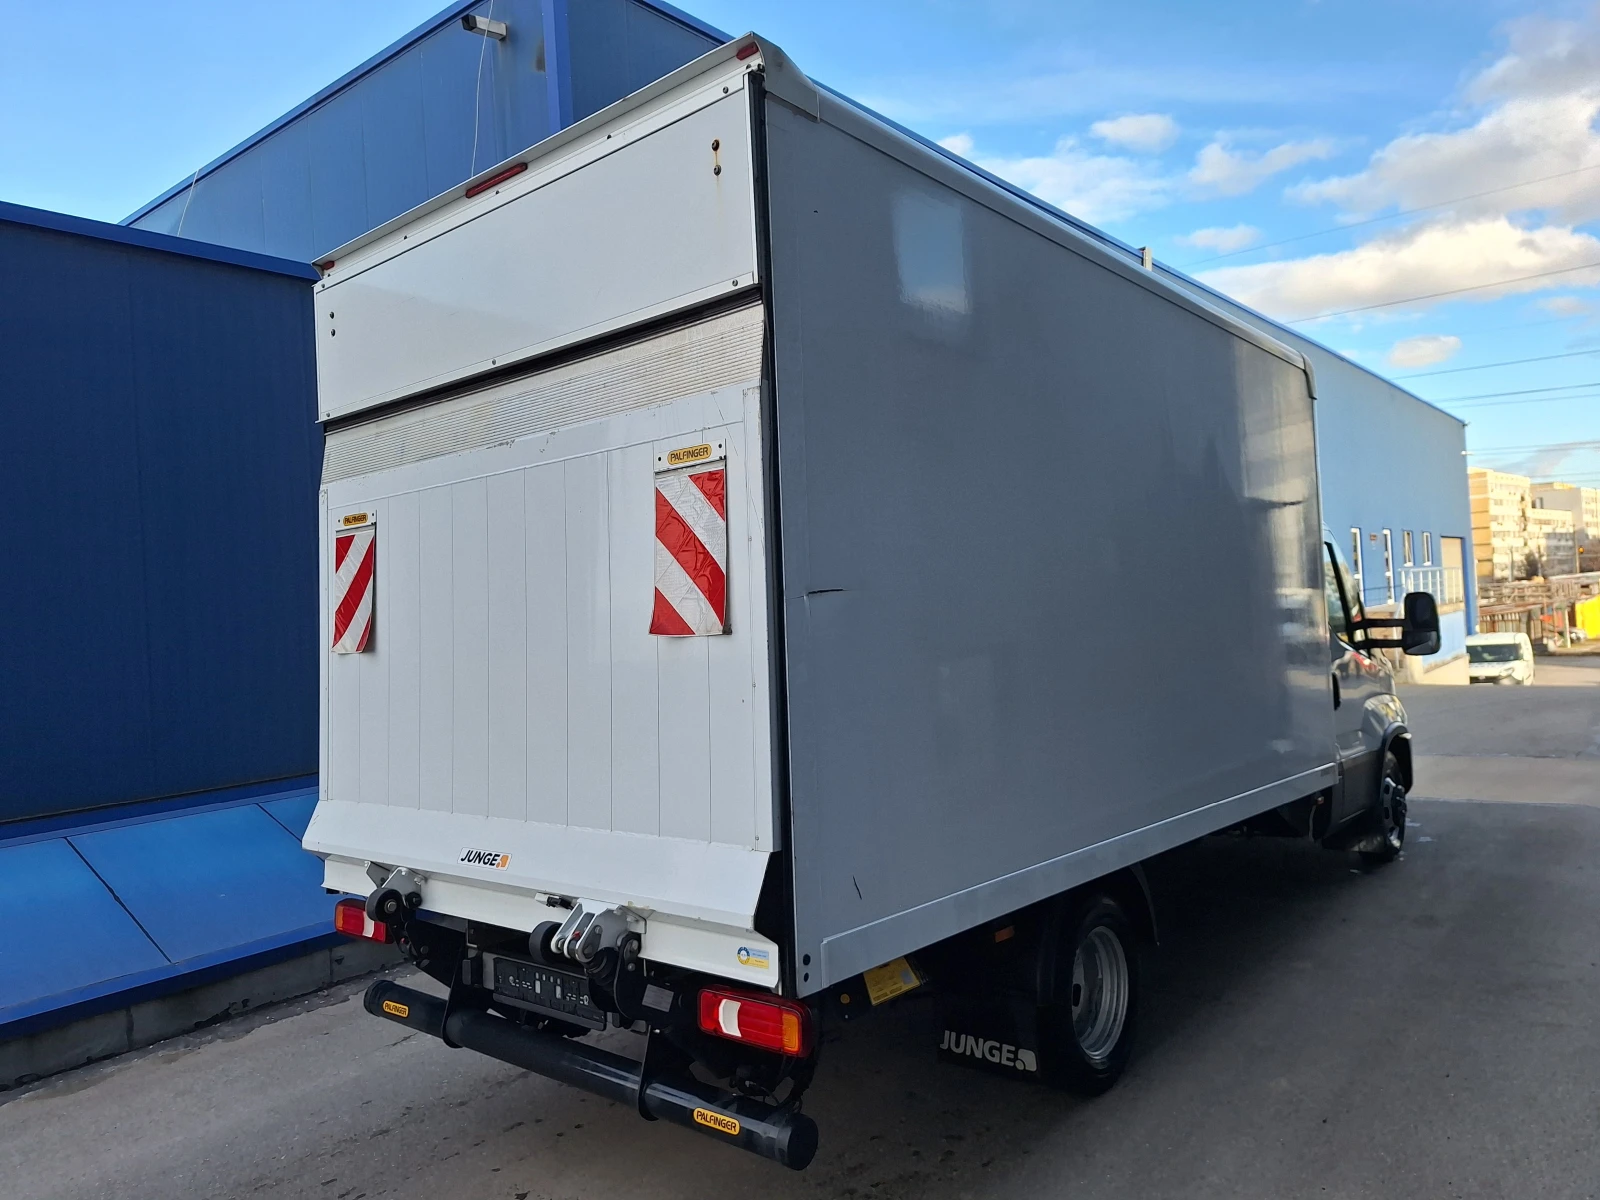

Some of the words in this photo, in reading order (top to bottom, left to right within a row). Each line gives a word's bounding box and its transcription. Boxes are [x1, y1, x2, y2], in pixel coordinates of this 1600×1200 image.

[670, 446, 709, 462] PALFINGER
[344, 514, 367, 525] PALFINGER
[460, 849, 501, 867] JUNGE
[940, 1029, 1016, 1067] JUNGE
[696, 1110, 737, 1132] PALFINGER
